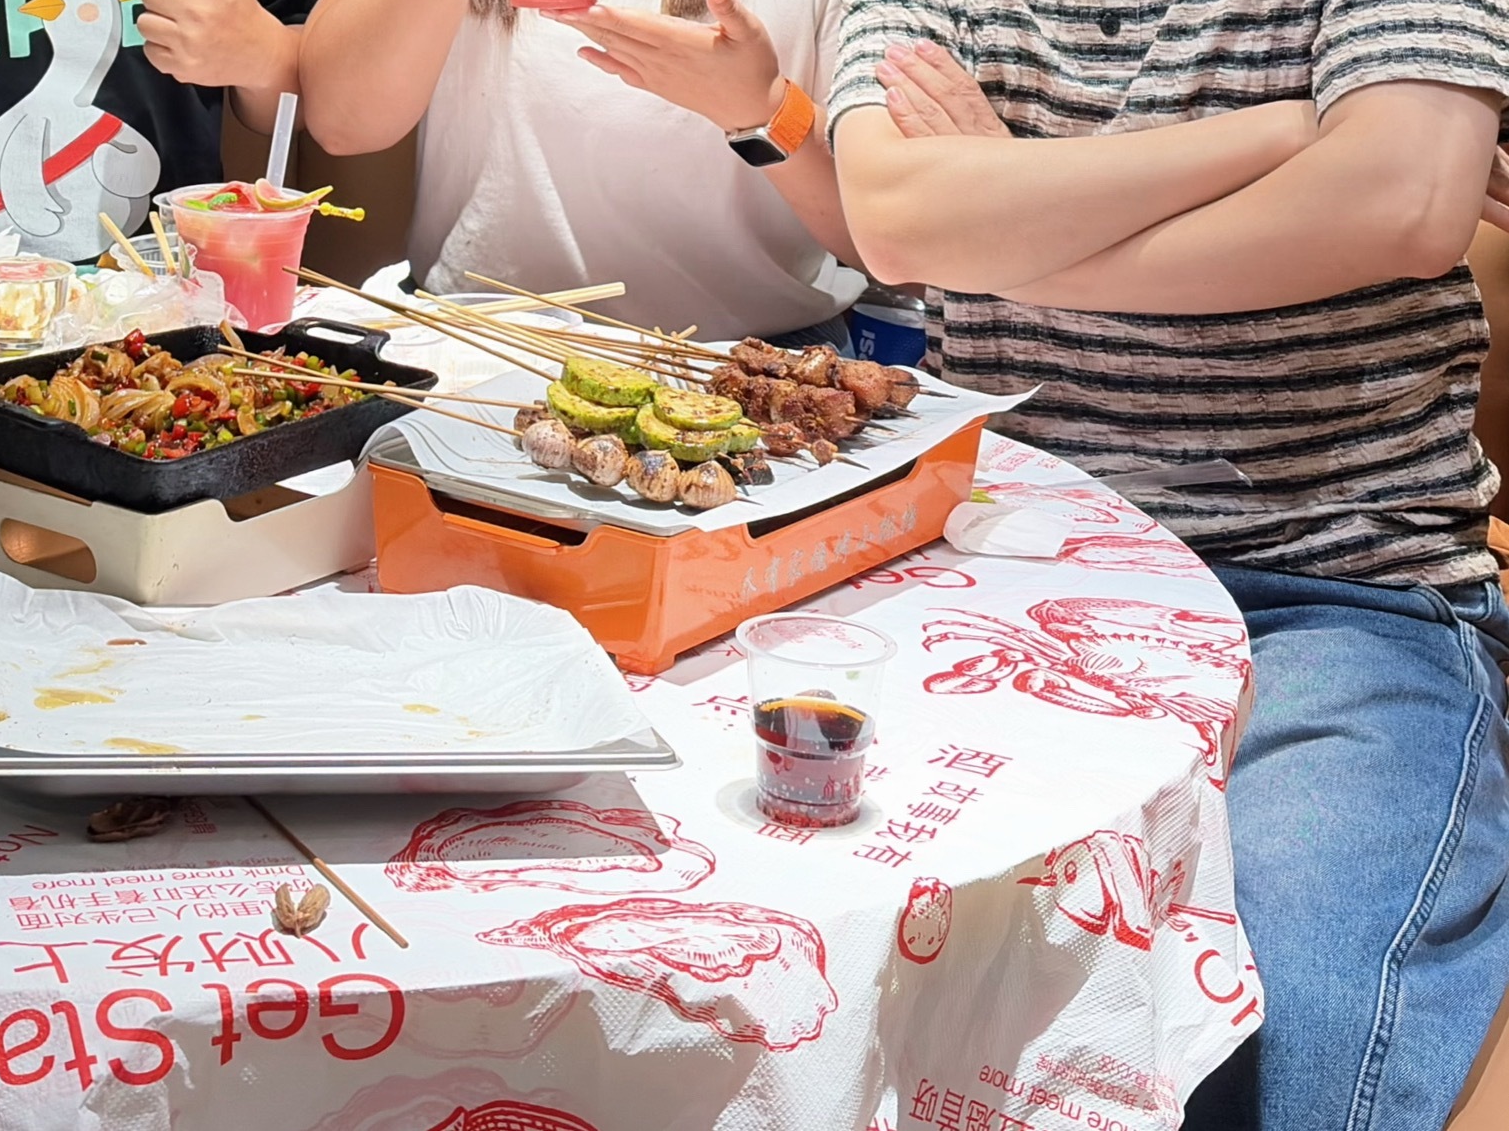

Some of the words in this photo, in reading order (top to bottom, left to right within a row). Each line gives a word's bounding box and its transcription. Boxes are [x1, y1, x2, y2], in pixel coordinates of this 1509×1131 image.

[103, 873, 167, 885] meet
[172, 869, 235, 880] more
[243, 865, 306, 877] Drink
[32, 878, 94, 890] more
[16, 898, 276, 930] 里的人已坐对面
[201, 973, 406, 1065] Get
[979, 1065, 1026, 1096] more
[1027, 1085, 1082, 1120] meet
